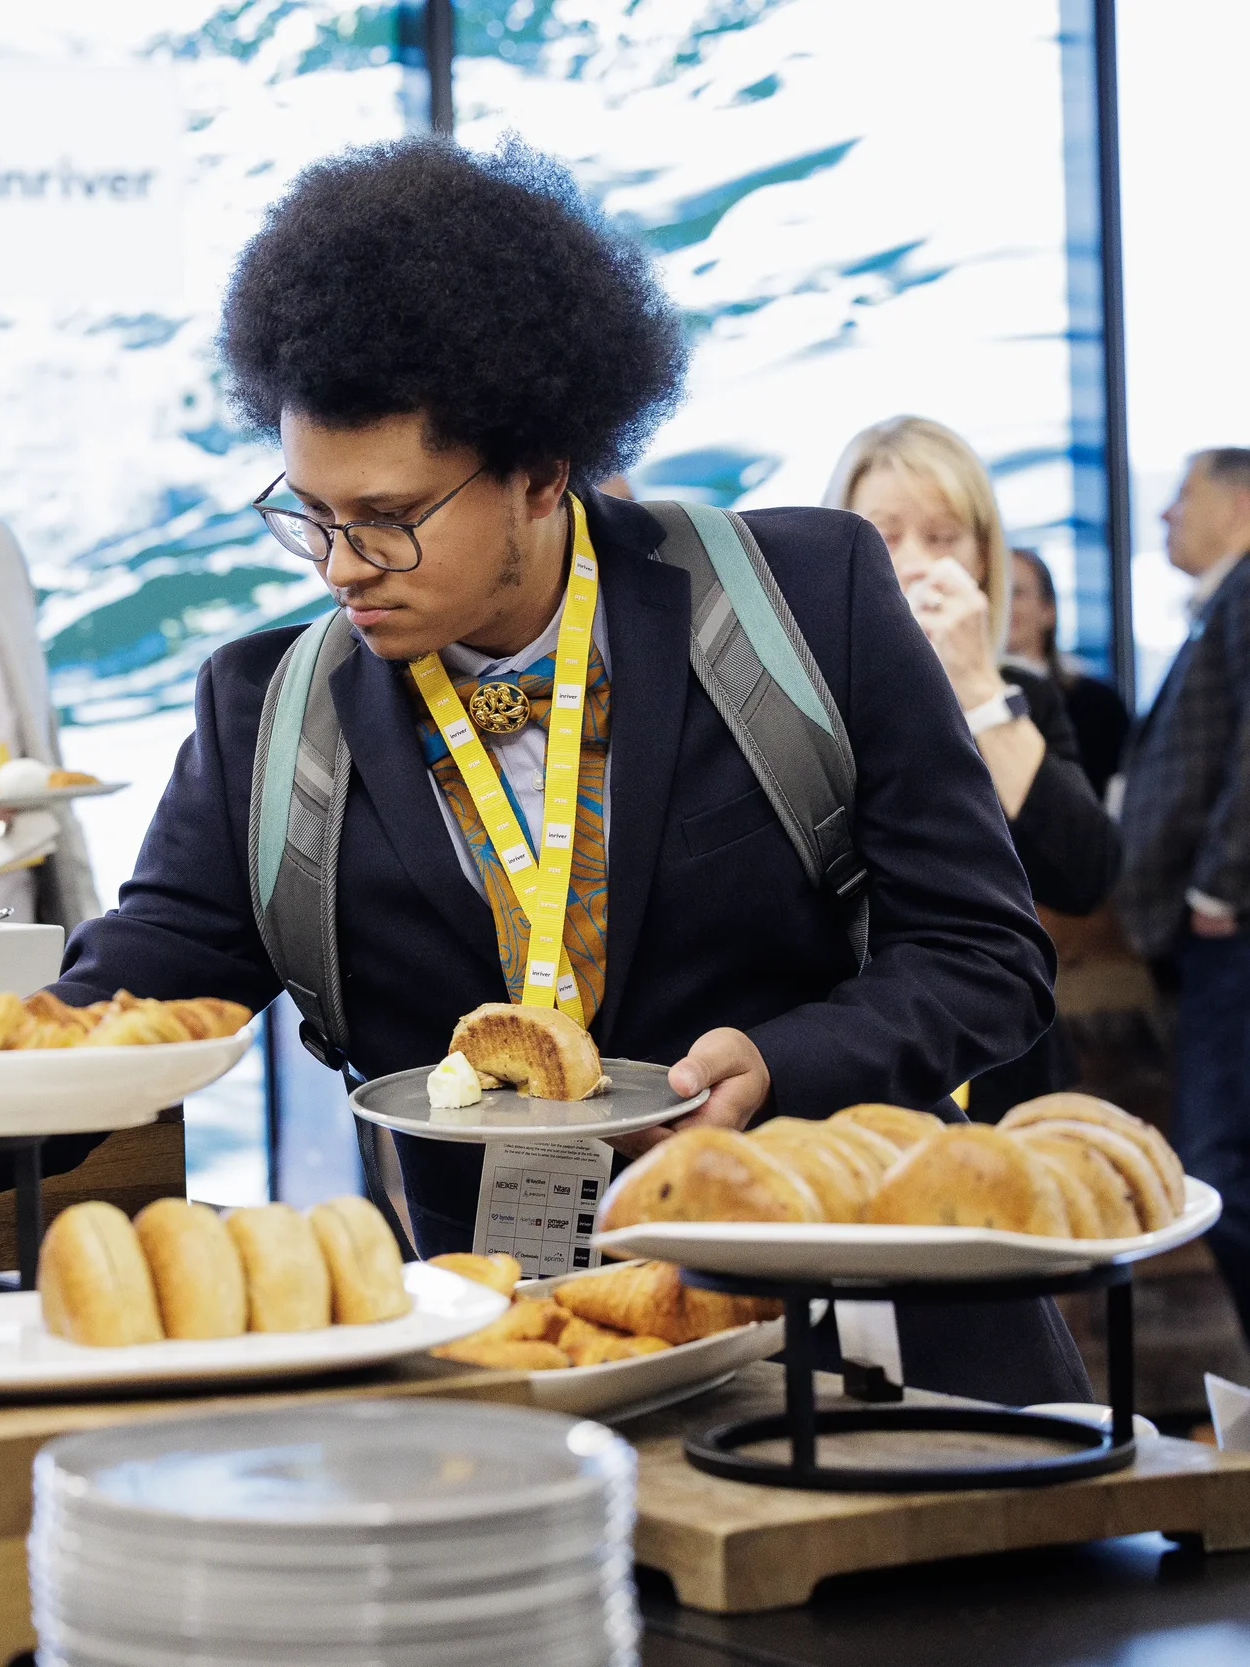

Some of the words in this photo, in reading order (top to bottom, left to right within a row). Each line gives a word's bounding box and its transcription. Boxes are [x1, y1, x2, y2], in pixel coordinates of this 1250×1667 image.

[577, 562, 593, 572] inriver
[450, 728, 468, 740] inriver
[549, 832, 568, 840] inriver
[508, 853, 526, 865] inriver
[532, 970, 551, 978] inriver
[558, 983, 573, 993] inriver
